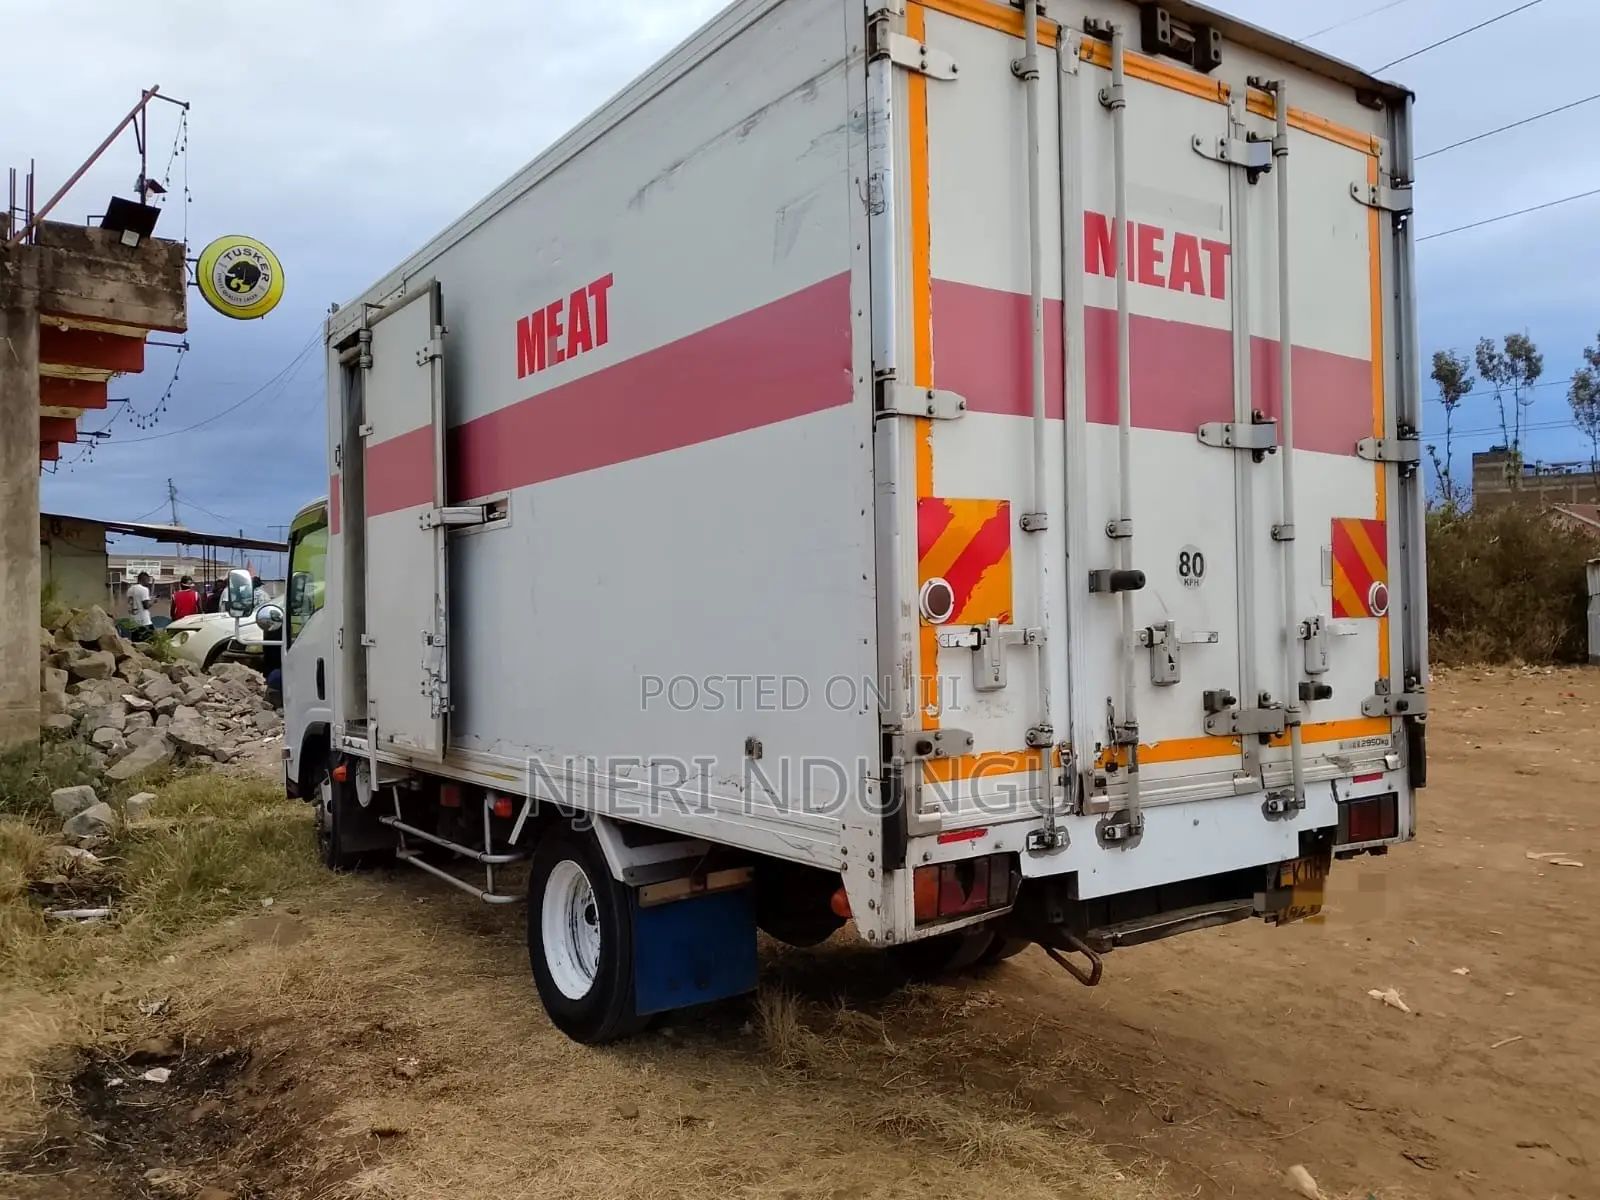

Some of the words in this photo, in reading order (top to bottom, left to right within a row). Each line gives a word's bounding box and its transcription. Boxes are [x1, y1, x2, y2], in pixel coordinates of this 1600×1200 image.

[223, 248, 269, 282] TUSKER
[1084, 210, 1232, 300] MEAT
[517, 272, 613, 380] MEAT
[1179, 551, 1204, 578] 80
